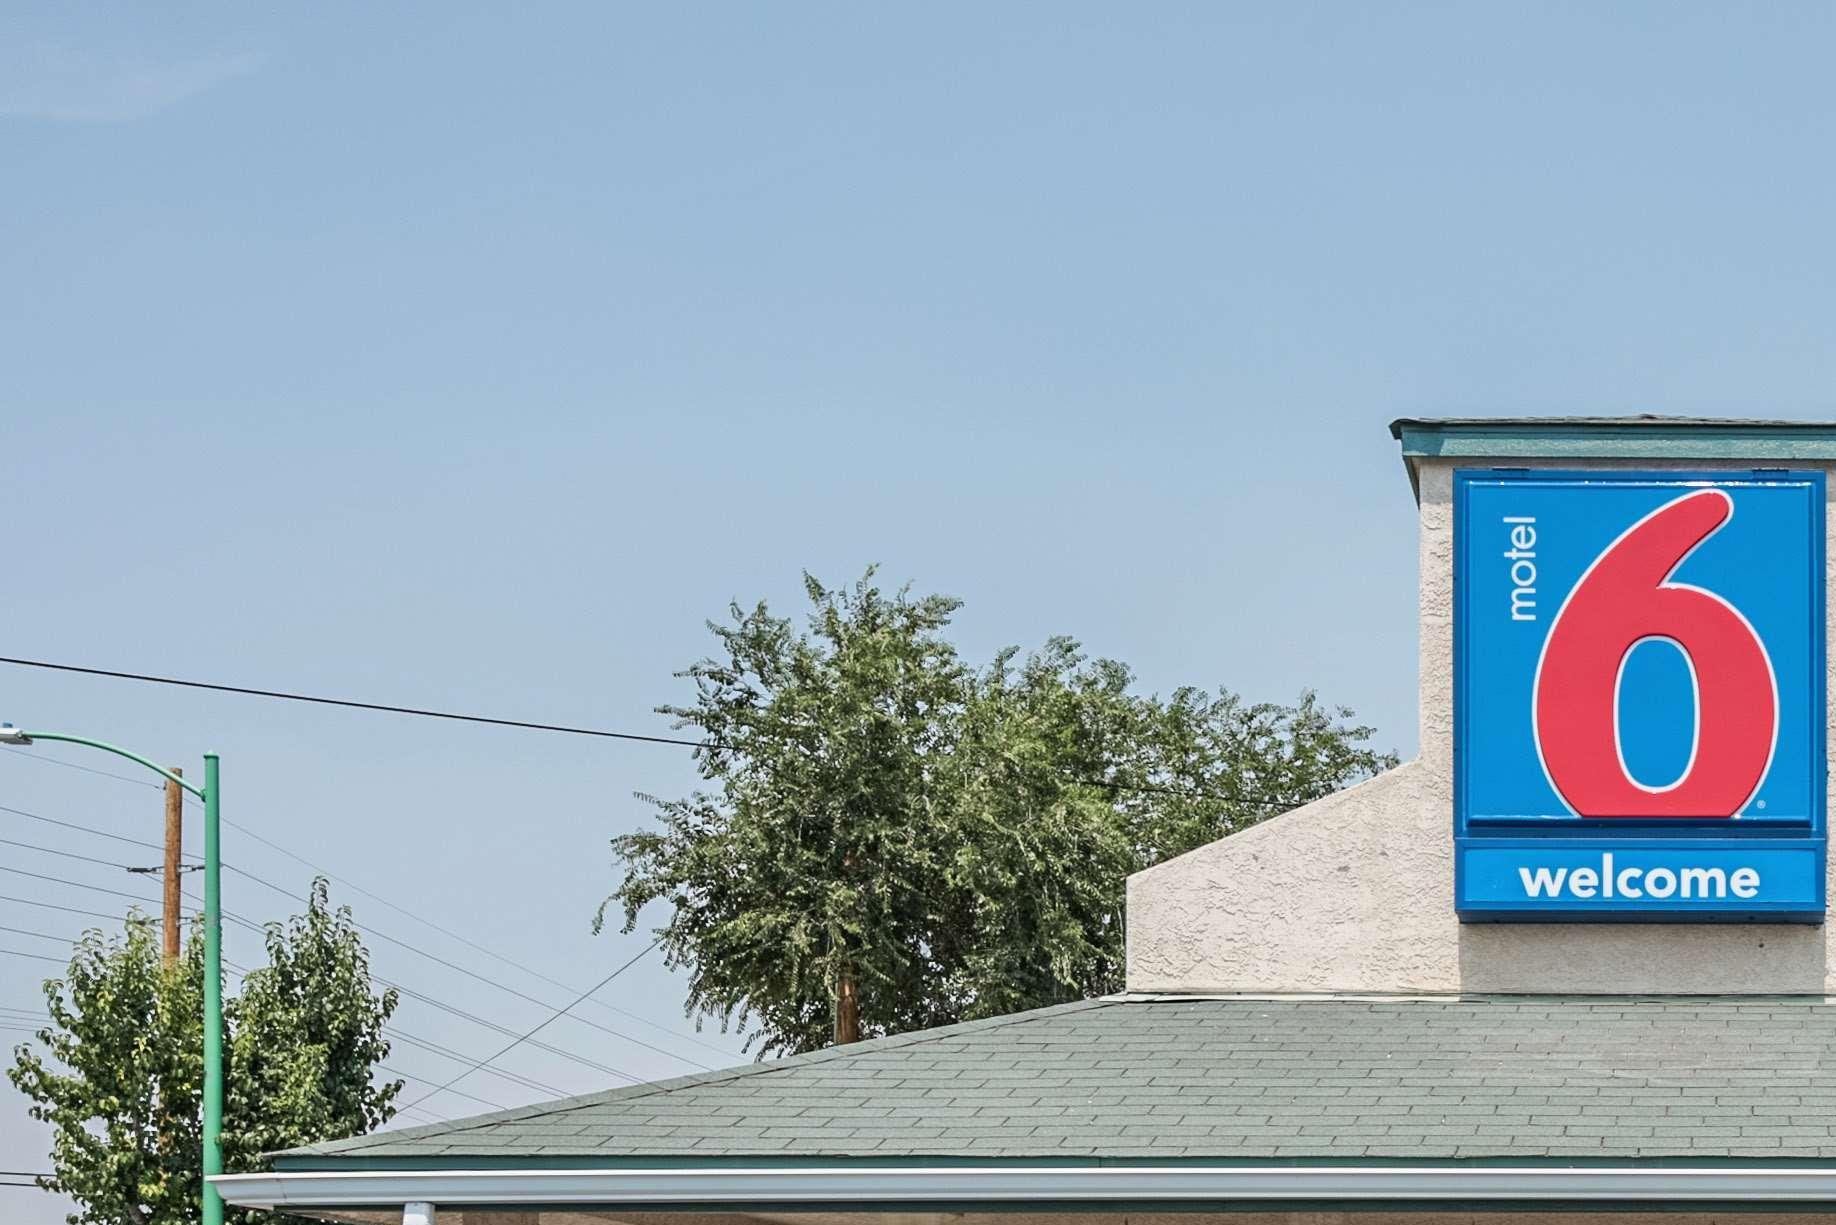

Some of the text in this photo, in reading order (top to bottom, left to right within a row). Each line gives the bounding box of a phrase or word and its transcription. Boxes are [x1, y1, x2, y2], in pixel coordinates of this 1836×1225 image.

[1504, 488, 1780, 817] motel 6
[1519, 853, 1760, 898] welcome
